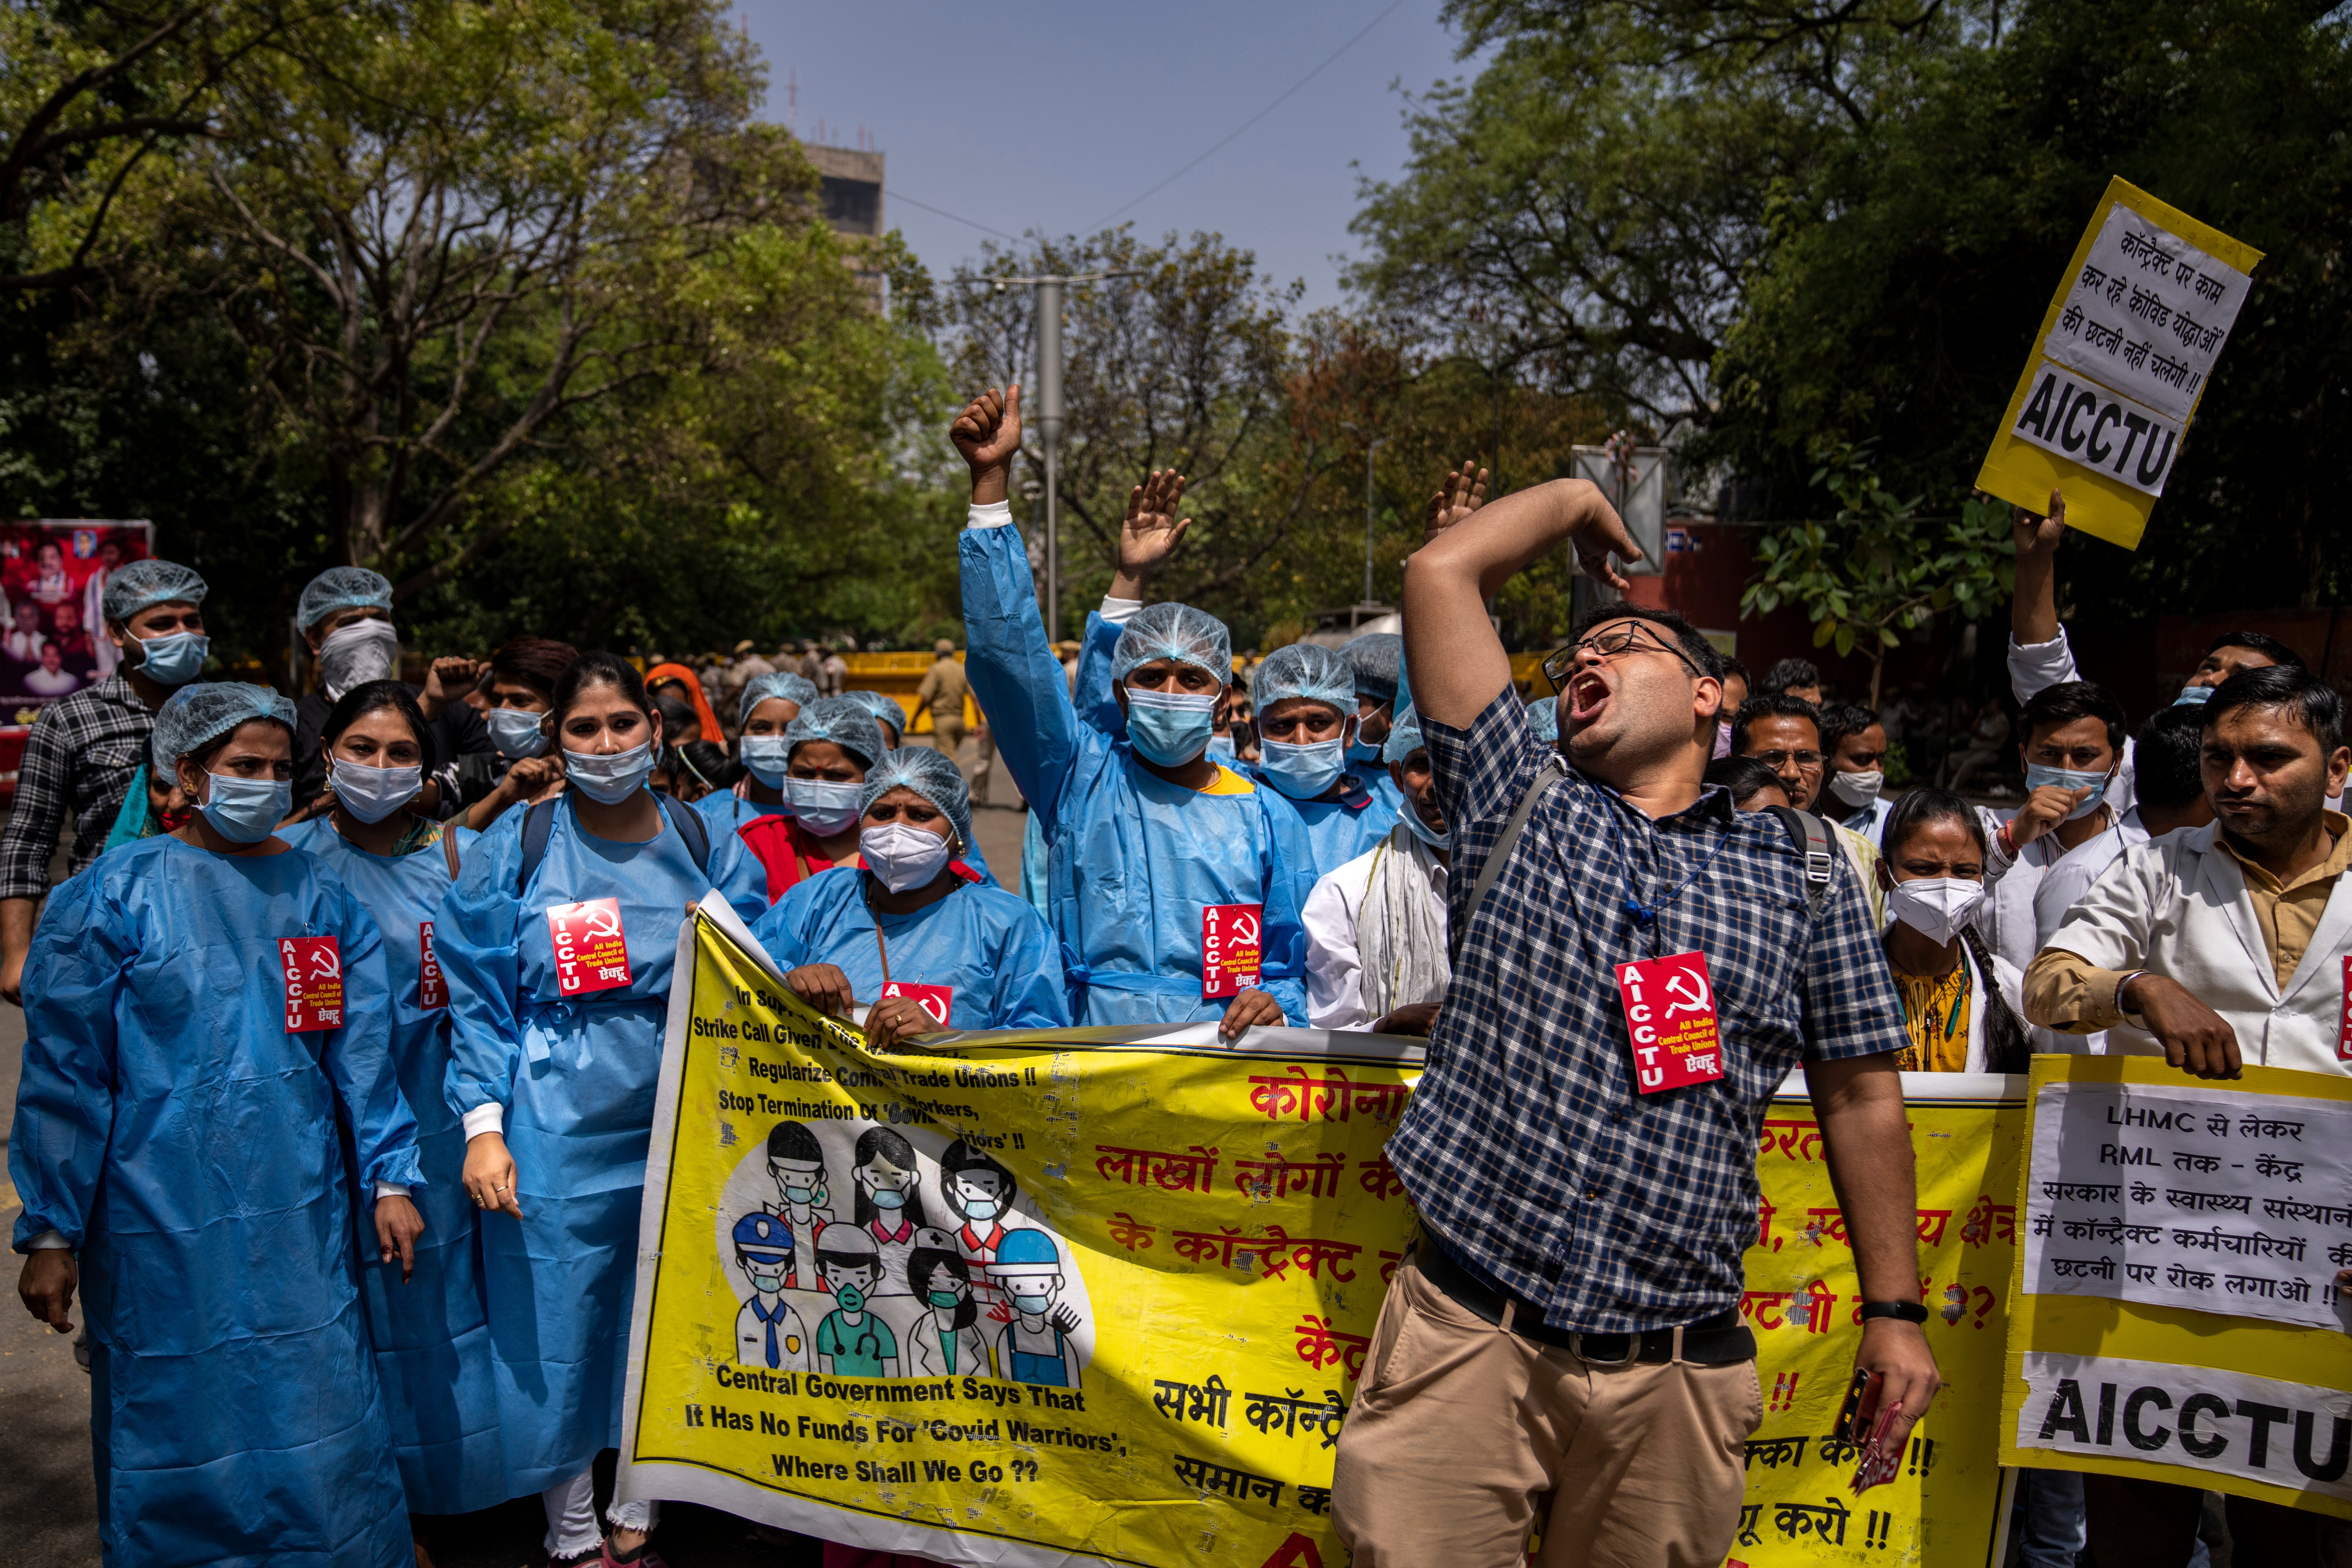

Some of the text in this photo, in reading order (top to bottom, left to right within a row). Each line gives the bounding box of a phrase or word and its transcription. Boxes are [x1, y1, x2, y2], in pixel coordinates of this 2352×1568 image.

[2082, 264, 2107, 294] कर
[2107, 276, 2127, 308] रहे
[2121, 230, 2225, 305] कॉन्ट्रैक्ट पर काम
[2062, 305, 2201, 395] की छटनी नहीं चलेगी !!
[2017, 373, 2176, 486] AICCTU
[1206, 908, 1220, 993] AICCTU
[283, 940, 302, 1028] AICCTU
[735, 985, 751, 1006] In
[828, 1023, 860, 1049] The
[1623, 966, 1664, 1087] AICCTU
[1658, 1027, 1716, 1046] Central Council of
[1679, 1017, 1714, 1031] All India
[694, 1016, 738, 1039] Strike
[742, 1020, 769, 1043] Call
[774, 1023, 822, 1049] Given
[901, 1069, 950, 1088] Trade
[955, 1068, 1019, 1088] Unions
[1024, 1067, 1037, 1086] !!
[749, 1056, 833, 1084] Regularize
[1670, 1039, 1717, 1055] Trade Unions
[719, 1090, 754, 1116] Stop
[757, 1093, 854, 1120] Termination
[859, 1103, 878, 1121] Of
[1012, 1132, 1025, 1149] !!
[1248, 1066, 1408, 1123] कोरोना
[2107, 1105, 2305, 1142] LHMC से लेकर
[1095, 1145, 1218, 1194] लाखों
[1235, 1150, 1345, 1199] लोगों
[2100, 1143, 2161, 1167] RML
[2172, 1151, 2221, 1174] तक
[2255, 1152, 2304, 1184] केंद्र
[2042, 1181, 2121, 1204] सरकार
[2130, 1181, 2157, 1205] के
[2166, 1189, 2252, 1215] स्वास्थ्य
[1106, 1212, 1156, 1252] के
[2033, 1214, 2055, 1238] में
[2172, 1225, 2307, 1262] कर्मचारियों
[2051, 1256, 2339, 1307] छटनी पर रोक लगाओ !!
[717, 1364, 1085, 1412] Central Government Says That
[1154, 1374, 1231, 1428] सभी
[1769, 1372, 1799, 1412] !!
[685, 1403, 1127, 1458] It Has No Funds For 'Covid Warriors',
[2038, 1378, 2352, 1483] AICCTU
[771, 1454, 1039, 1483] Where Shall We Go ??
[1174, 1454, 1285, 1508] समान
[1908, 1437, 1935, 1478] !!
[1774, 1497, 1851, 1547] करो
[1865, 1509, 1891, 1550] !!
